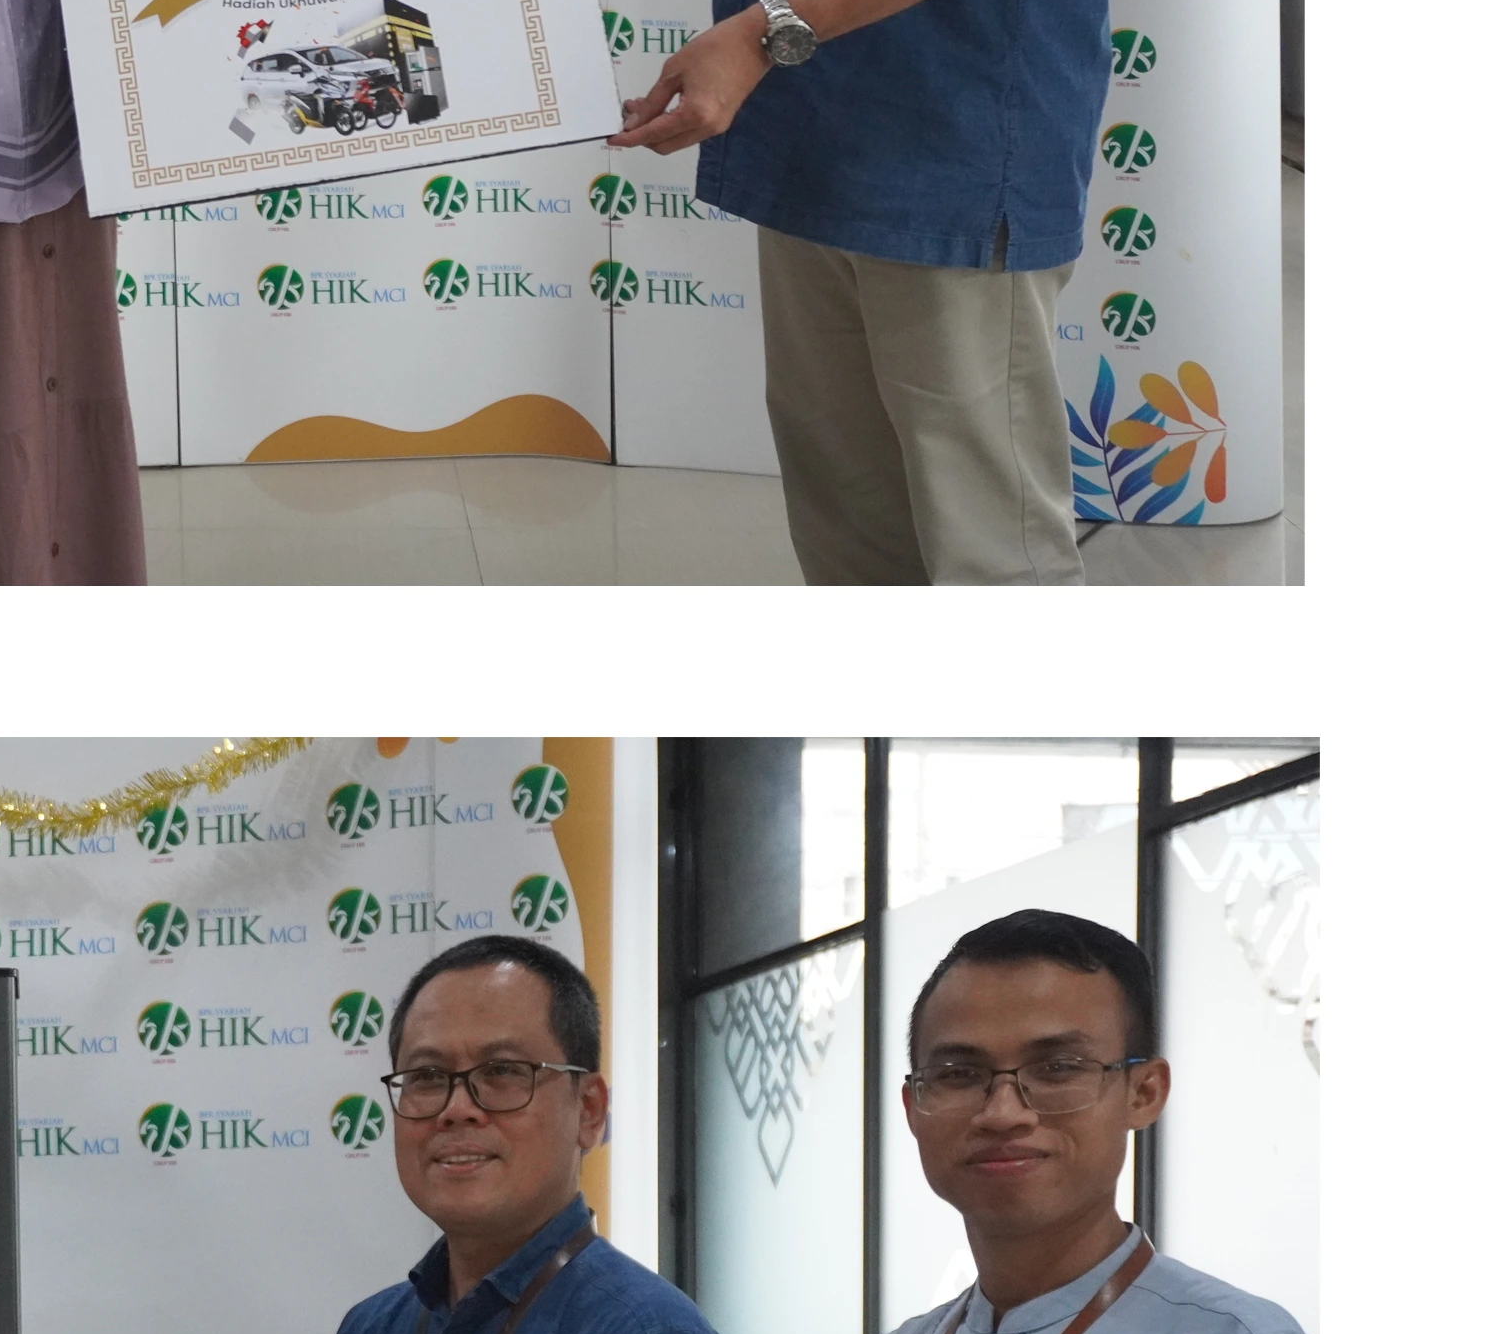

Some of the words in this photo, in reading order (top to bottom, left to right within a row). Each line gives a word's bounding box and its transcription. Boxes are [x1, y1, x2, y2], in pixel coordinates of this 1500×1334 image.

[223, 0, 275, 9] Hadiah
[476, 188, 535, 213] HIK
[538, 199, 570, 213] MCI
[198, 813, 264, 845] HIK
[269, 823, 305, 838] MCI
[201, 1119, 268, 1149] HIK
[272, 1130, 309, 1147] MCI
